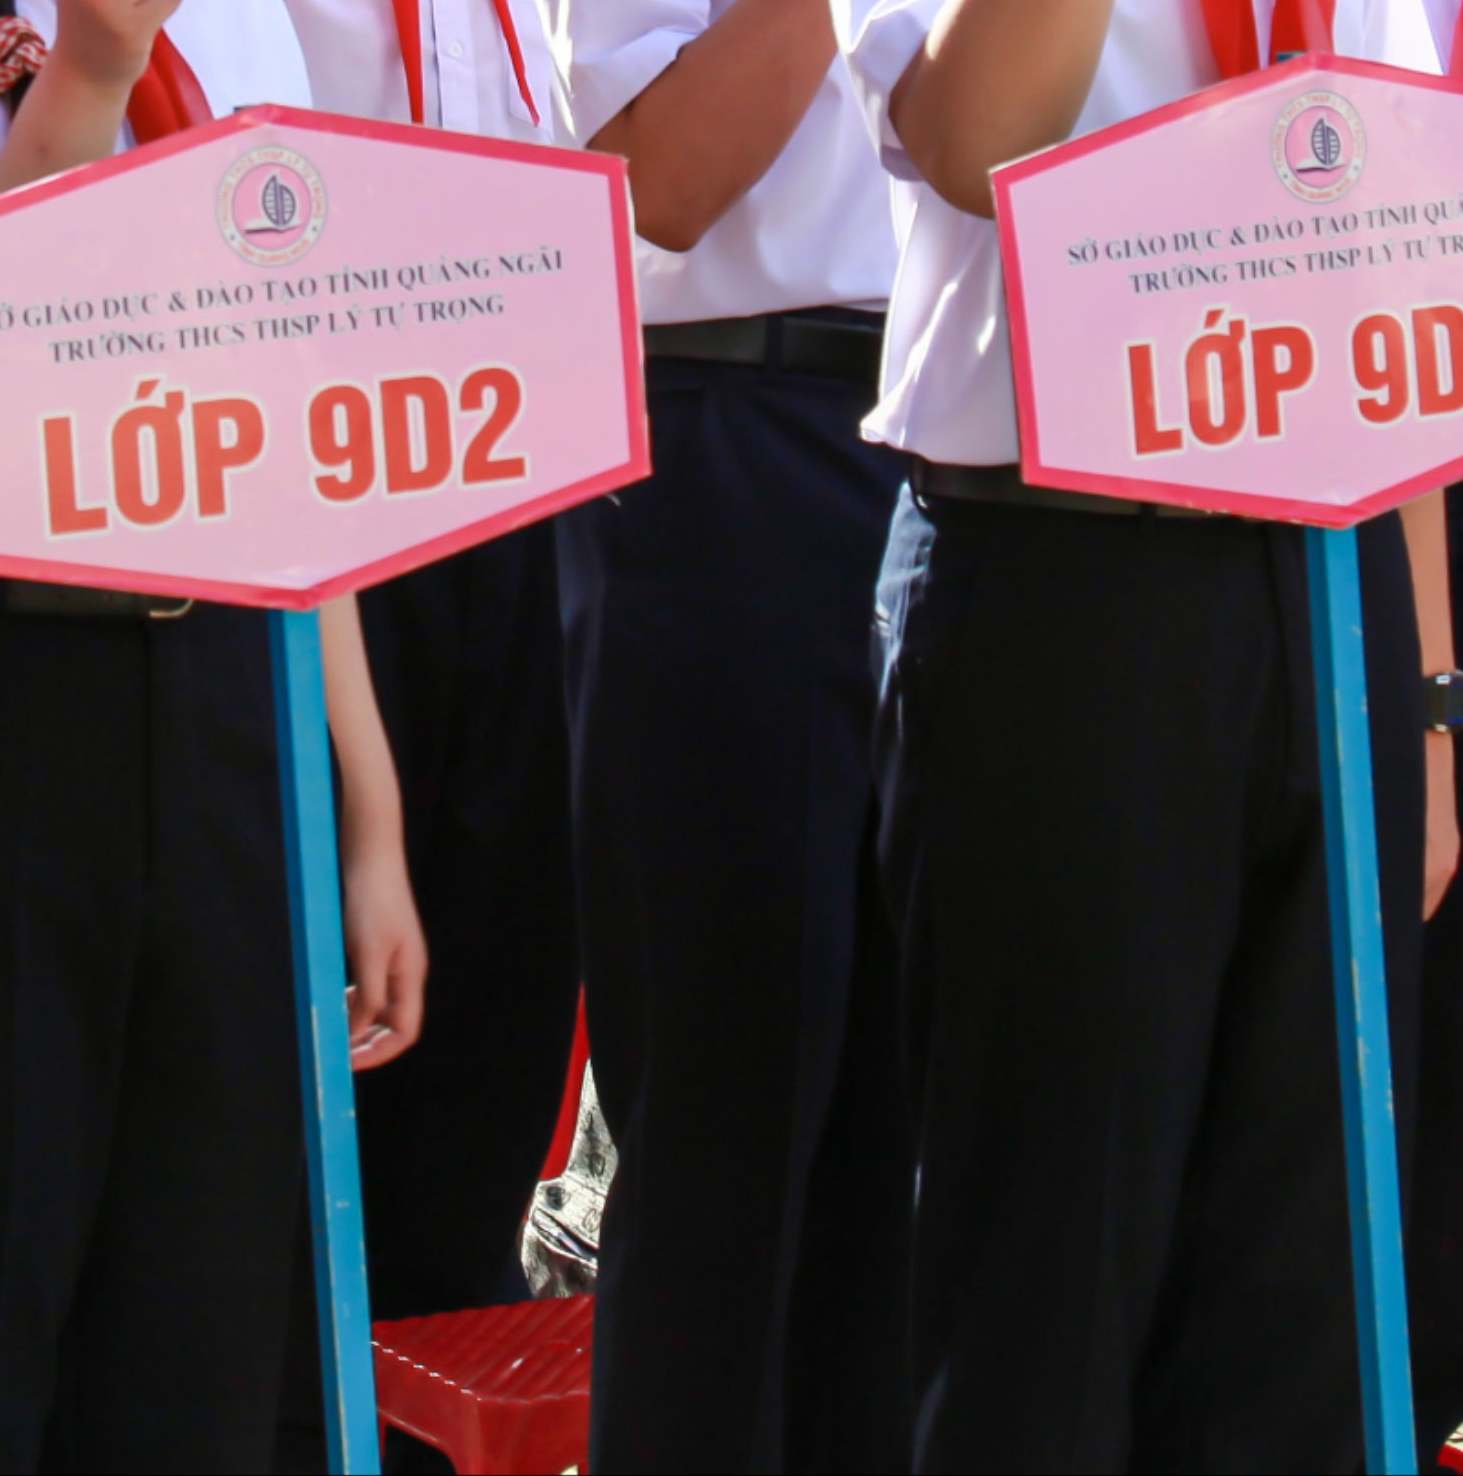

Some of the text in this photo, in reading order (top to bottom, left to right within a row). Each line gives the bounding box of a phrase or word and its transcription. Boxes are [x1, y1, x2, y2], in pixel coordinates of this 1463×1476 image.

[1106, 234, 1167, 260] GIÁO
[1173, 228, 1222, 256] DỤC
[1230, 225, 1246, 246] &
[1311, 213, 1358, 238] TẠO
[1236, 257, 1296, 281] THCS
[1304, 248, 1361, 272] THSP
[1368, 238, 1395, 265] LÝ
[23, 298, 94, 328] GIÁO
[103, 294, 159, 322] DỤC
[168, 292, 187, 312] &
[262, 276, 318, 305] TẠO
[175, 325, 246, 350] THCS
[253, 314, 320, 341] THSP
[329, 305, 361, 333] LÝ
[413, 294, 505, 324] TRỌNG
[1128, 309, 1314, 454] LỚP
[43, 368, 525, 534] LỚP 9D2
